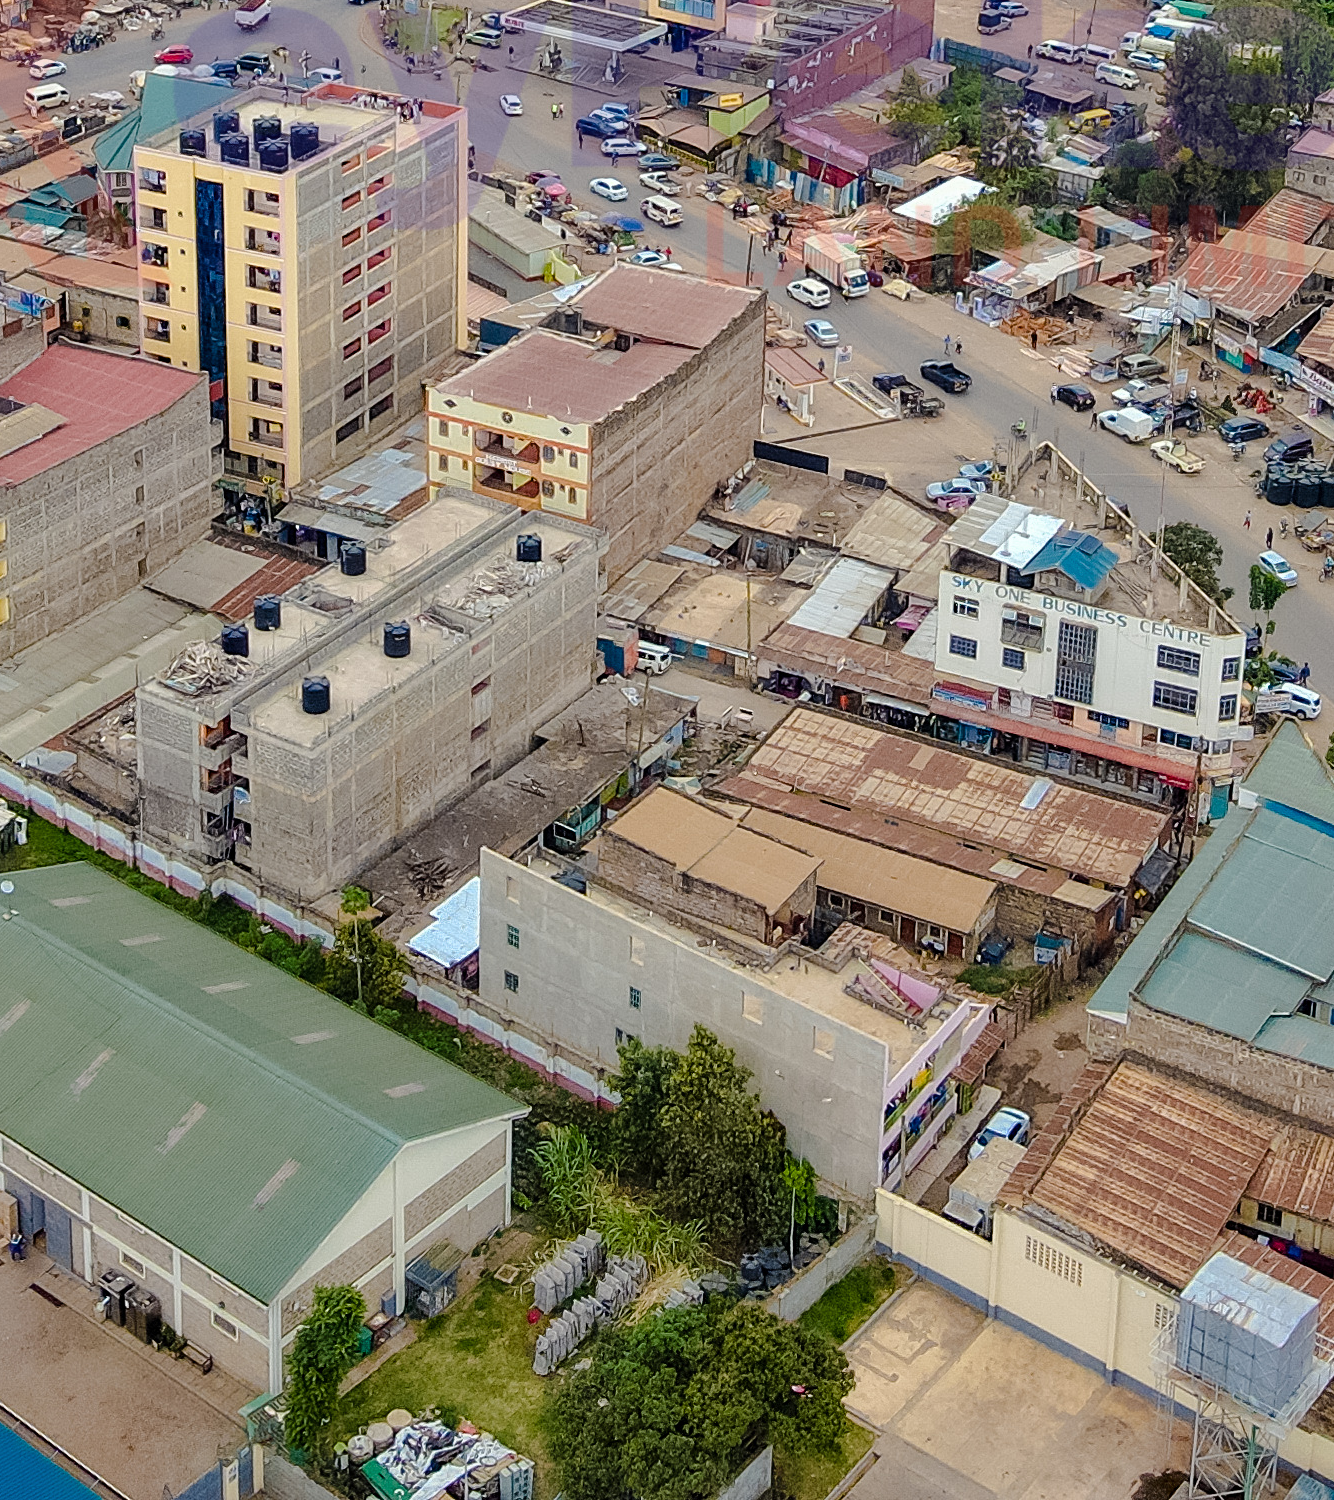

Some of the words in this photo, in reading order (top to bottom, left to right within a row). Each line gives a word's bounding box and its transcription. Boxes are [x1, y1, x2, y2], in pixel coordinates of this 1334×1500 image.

[1309, 371, 1334, 392] Bata
[951, 575, 985, 593] SKY
[995, 585, 1032, 605] ONE
[1042, 597, 1127, 628] BUSINESS
[1140, 619, 1211, 647] CENTRE
